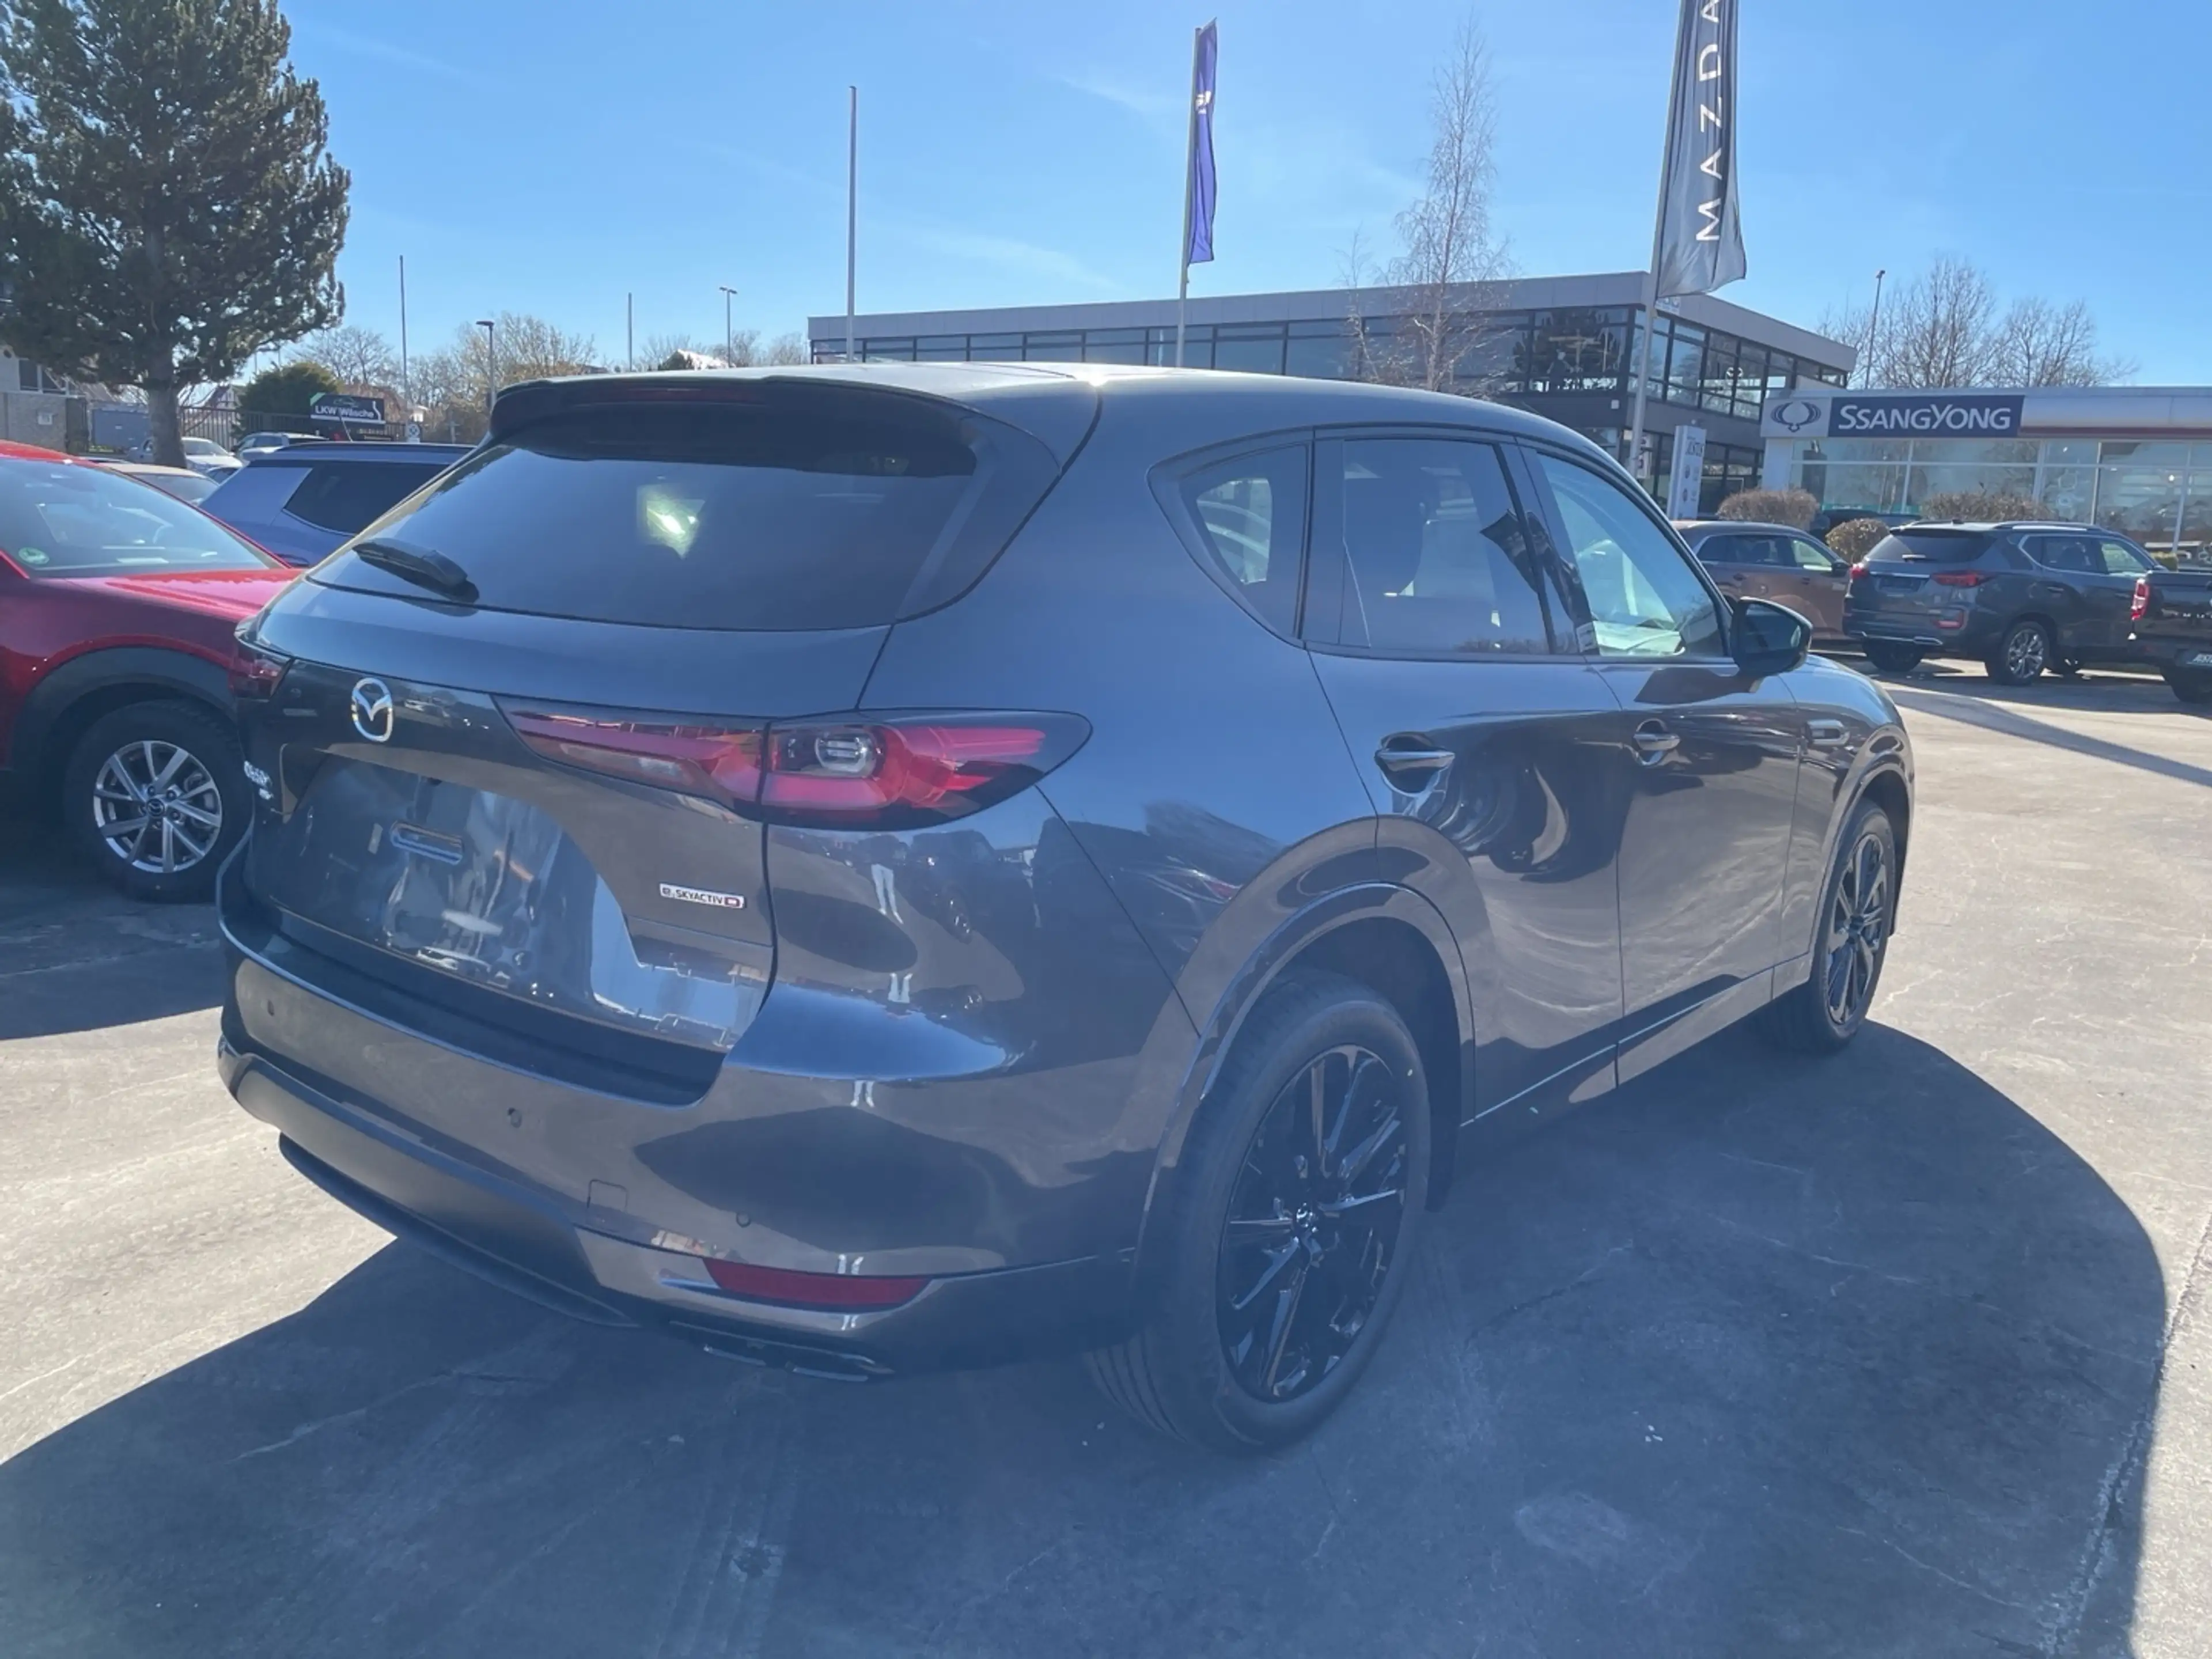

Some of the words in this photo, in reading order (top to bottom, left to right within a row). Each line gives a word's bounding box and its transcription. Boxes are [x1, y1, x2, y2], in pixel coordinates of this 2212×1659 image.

[1695, 0, 1722, 241] MAZDA
[315, 405, 336, 415] LKW
[1838, 403, 2012, 430] SSANGYONG
